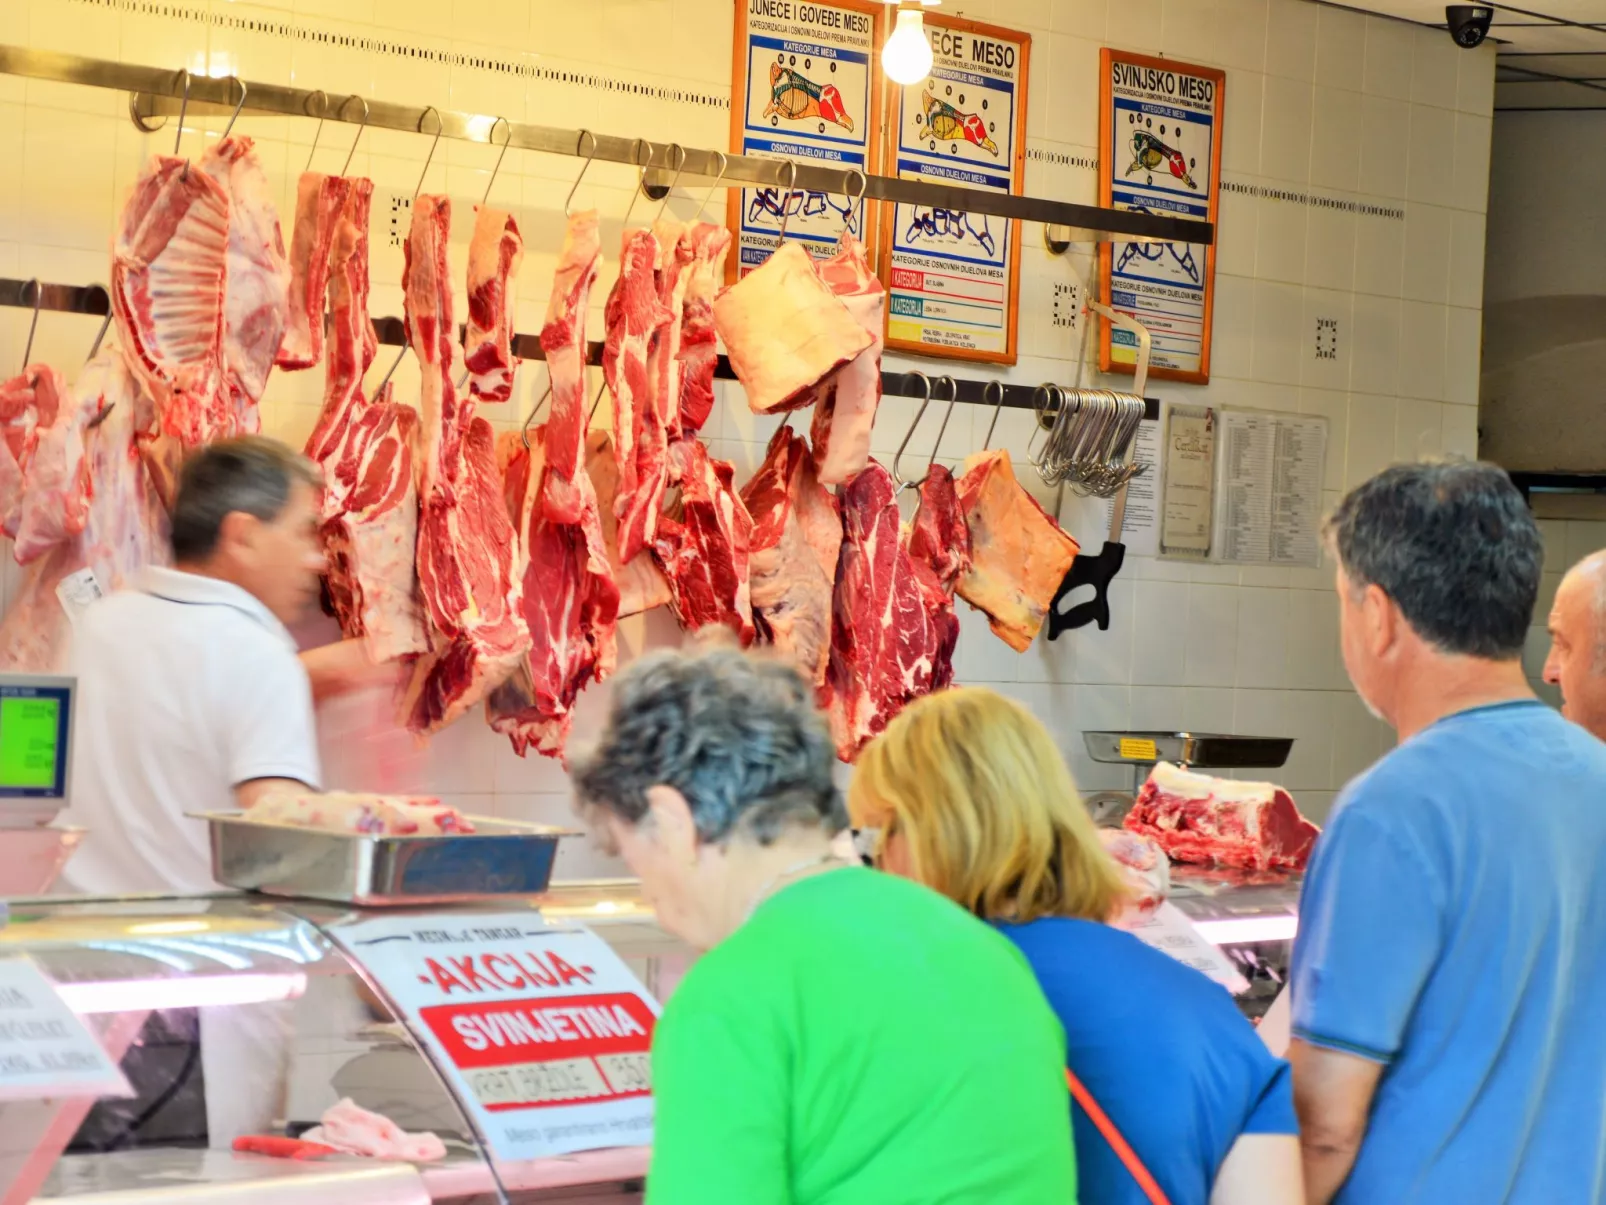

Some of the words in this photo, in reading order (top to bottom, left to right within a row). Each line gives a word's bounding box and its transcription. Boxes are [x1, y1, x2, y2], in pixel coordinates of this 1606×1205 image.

[793, 5, 797, 20] I
[799, 6, 841, 28] GOVEĐE
[843, 13, 869, 34] MESO
[791, 26, 811, 37] OSNOVNI
[831, 32, 846, 43] PREMA
[783, 41, 820, 55] KATEGORIJE
[821, 47, 837, 58] MESA
[972, 39, 1015, 68] MESO
[978, 64, 992, 73] PREMA
[968, 75, 984, 85] MESA
[1113, 63, 1175, 94] SVINJSKO
[1179, 75, 1213, 102] MESO
[1141, 104, 1172, 116] KATEGORIJE
[1172, 109, 1187, 119] MESA
[771, 142, 798, 155] OSNOVNI
[798, 146, 824, 159] DIJELOVI
[825, 150, 842, 160] MESA
[921, 164, 945, 177] OSNOVNI
[946, 168, 970, 181] DIJELOVI
[971, 173, 987, 184] MESA
[1176, 203, 1190, 213] MESA
[892, 255, 930, 267] KATEGORIJE
[931, 260, 960, 272] OSNOVNIH
[960, 265, 987, 275] DIJELOVA
[988, 269, 1004, 279] MESA
[422, 948, 592, 995] AKCIJA
[451, 1004, 647, 1051] SVINJETINA
